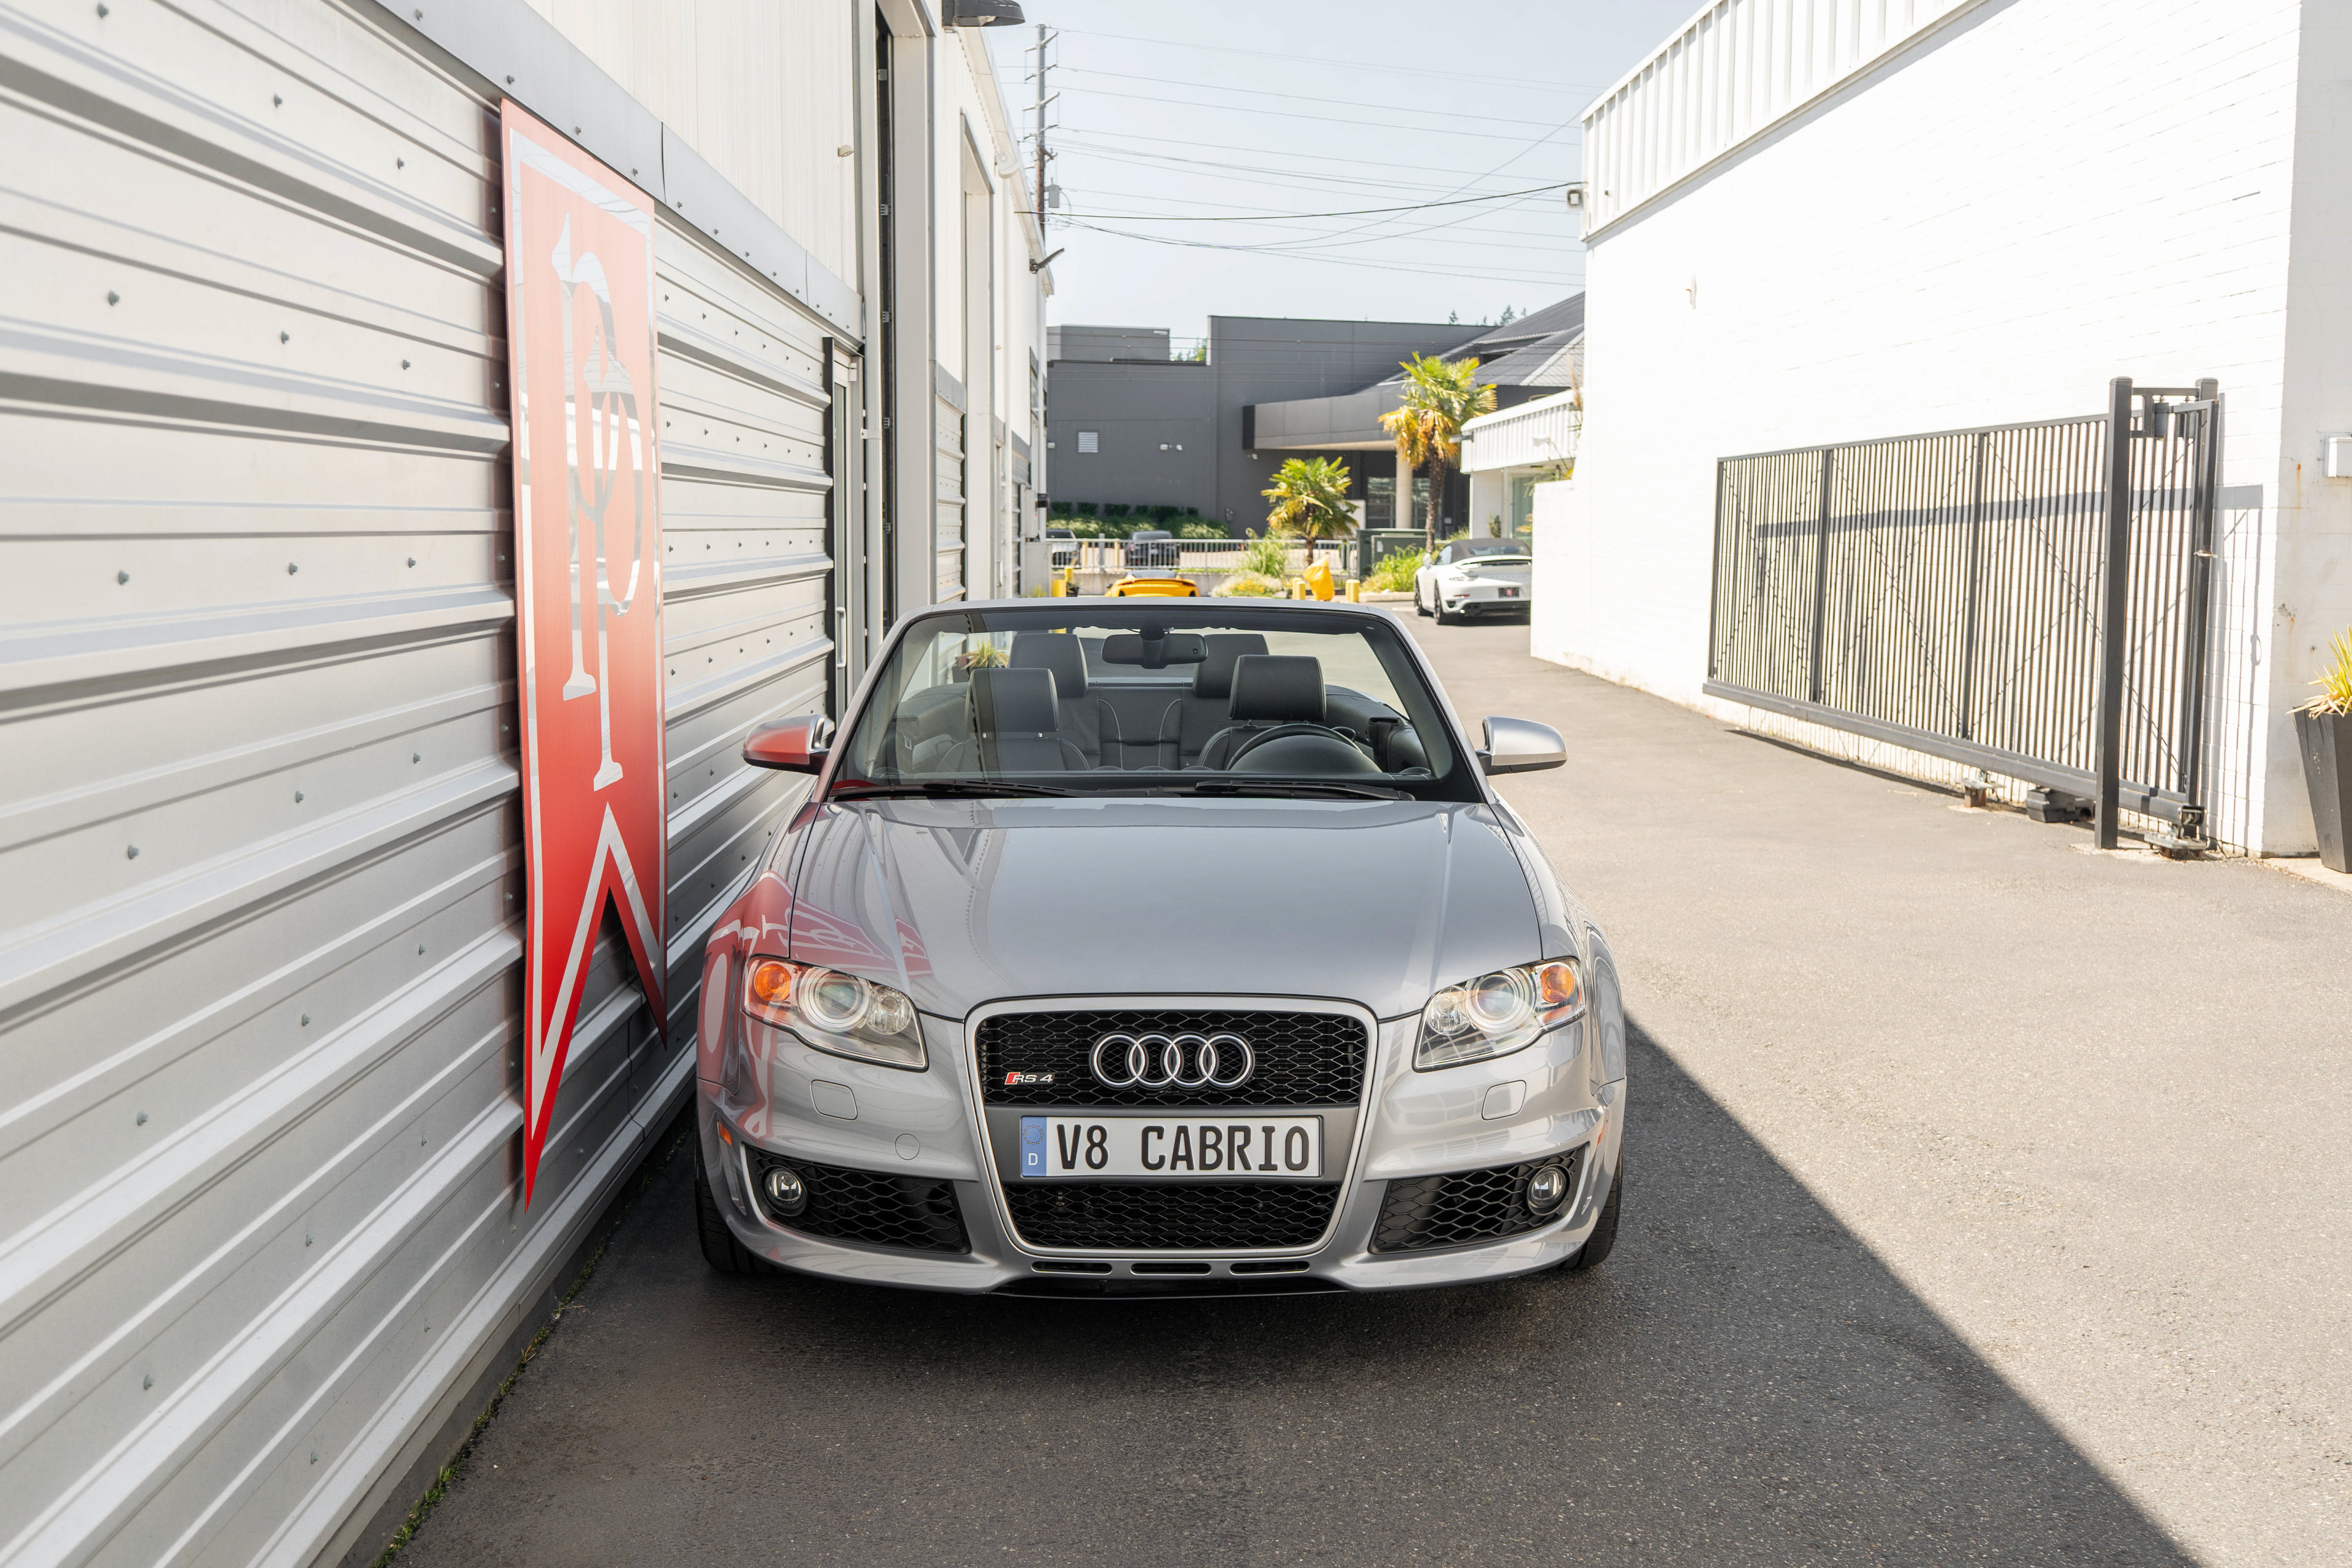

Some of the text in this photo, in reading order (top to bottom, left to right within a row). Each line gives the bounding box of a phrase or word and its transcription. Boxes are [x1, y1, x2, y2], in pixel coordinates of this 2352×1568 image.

[1012, 1074, 1053, 1083] RS 4
[1056, 1124, 1310, 1171] V8 CABRIO
[1028, 1153, 1038, 1166] D
